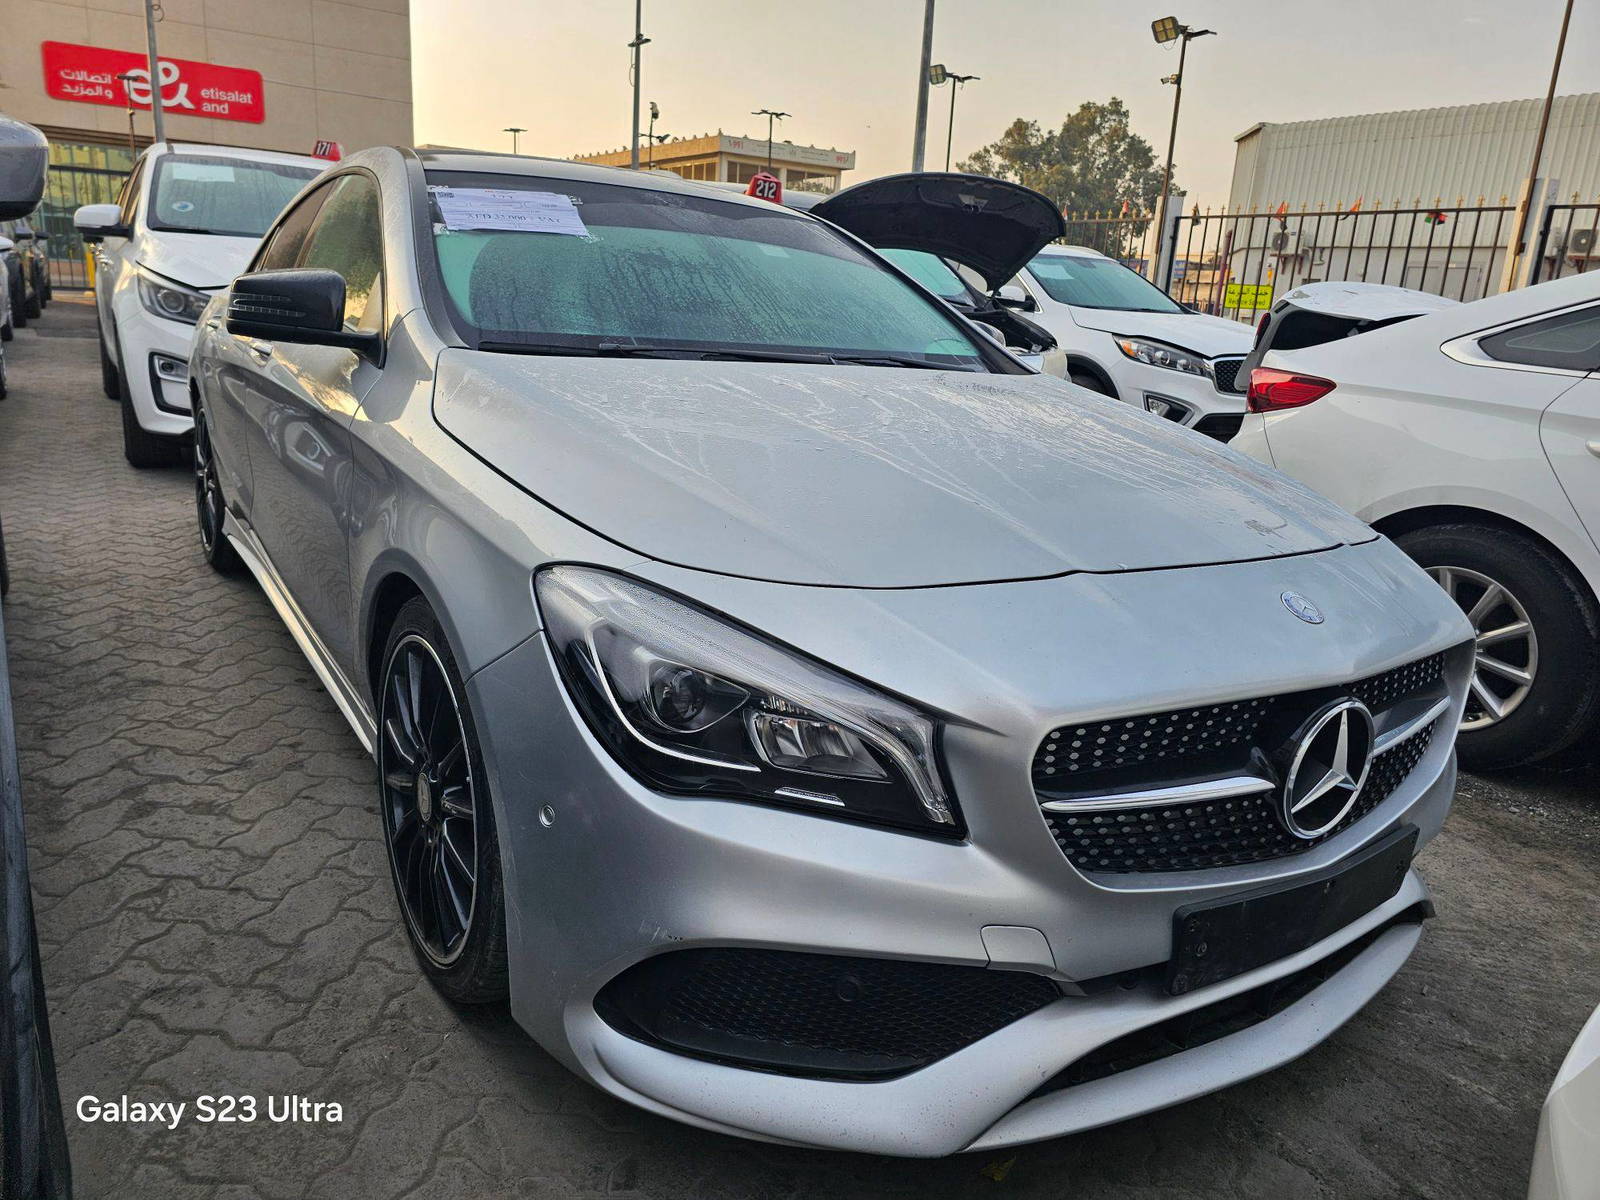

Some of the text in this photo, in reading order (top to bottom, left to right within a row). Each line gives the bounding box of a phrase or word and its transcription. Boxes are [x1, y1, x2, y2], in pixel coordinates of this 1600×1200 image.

[60, 69, 112, 85] اتصالات
[200, 88, 253, 105] etisalat
[201, 101, 229, 114] and
[316, 141, 331, 157] 171
[756, 180, 777, 199] 212
